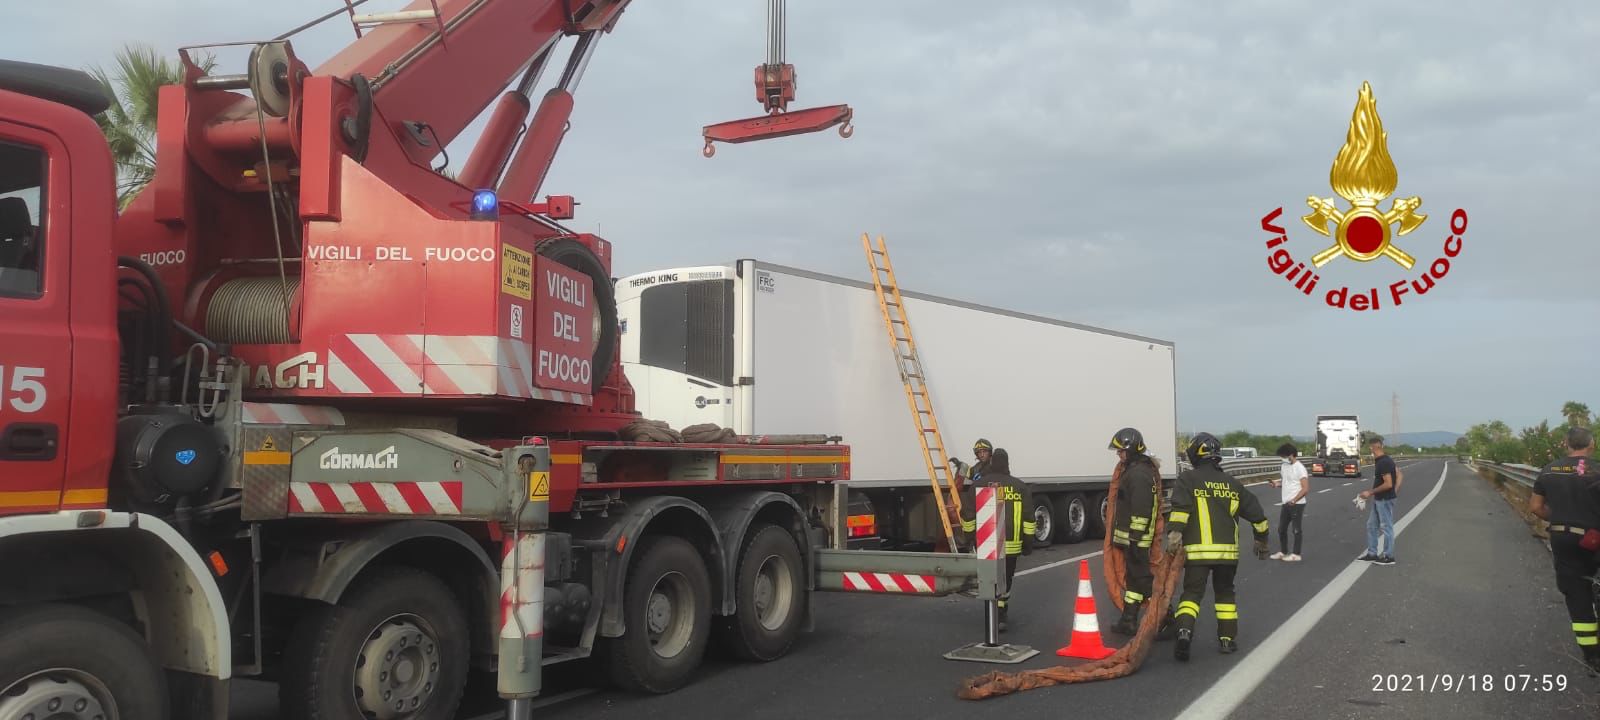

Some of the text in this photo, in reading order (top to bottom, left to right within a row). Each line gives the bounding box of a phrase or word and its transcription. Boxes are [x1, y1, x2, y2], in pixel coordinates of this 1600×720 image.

[308, 245, 496, 262] VIGILI DEL FUOCO
[547, 269, 585, 308] VIGILI
[629, 276, 656, 288] THERMO
[658, 273, 679, 283] KING
[759, 276, 775, 287] FRC
[553, 311, 580, 343] DEL
[538, 349, 591, 385] FUOCO
[320, 445, 398, 469] CORMACH
[1194, 488, 1211, 498] DEL
[1204, 481, 1230, 490] VIGILI
